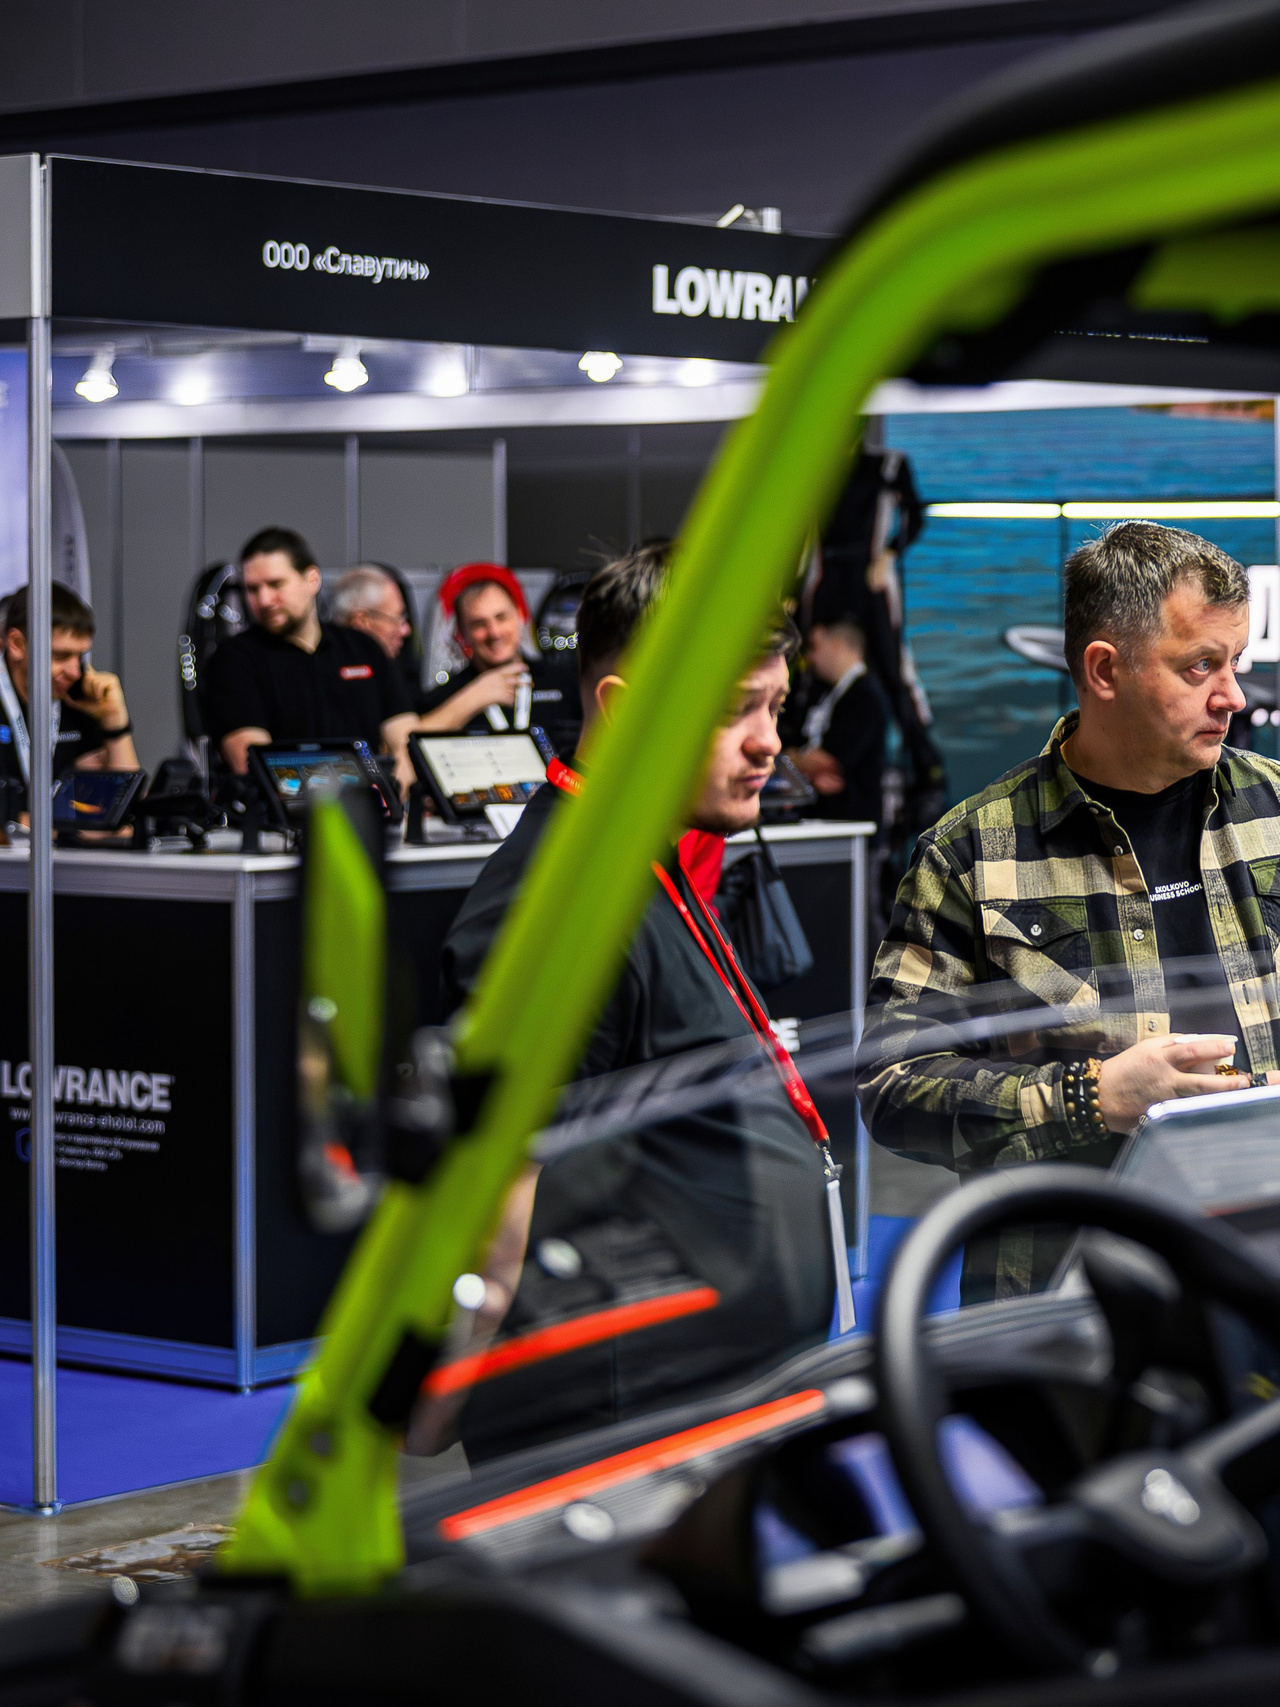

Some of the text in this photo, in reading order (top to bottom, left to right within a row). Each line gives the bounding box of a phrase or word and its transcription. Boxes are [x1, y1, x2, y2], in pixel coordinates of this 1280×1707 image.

[652, 264, 815, 323] LOWRA
[1149, 883, 1203, 902] USINESS SCHOOL
[1154, 881, 1190, 894] SKOLKOVO
